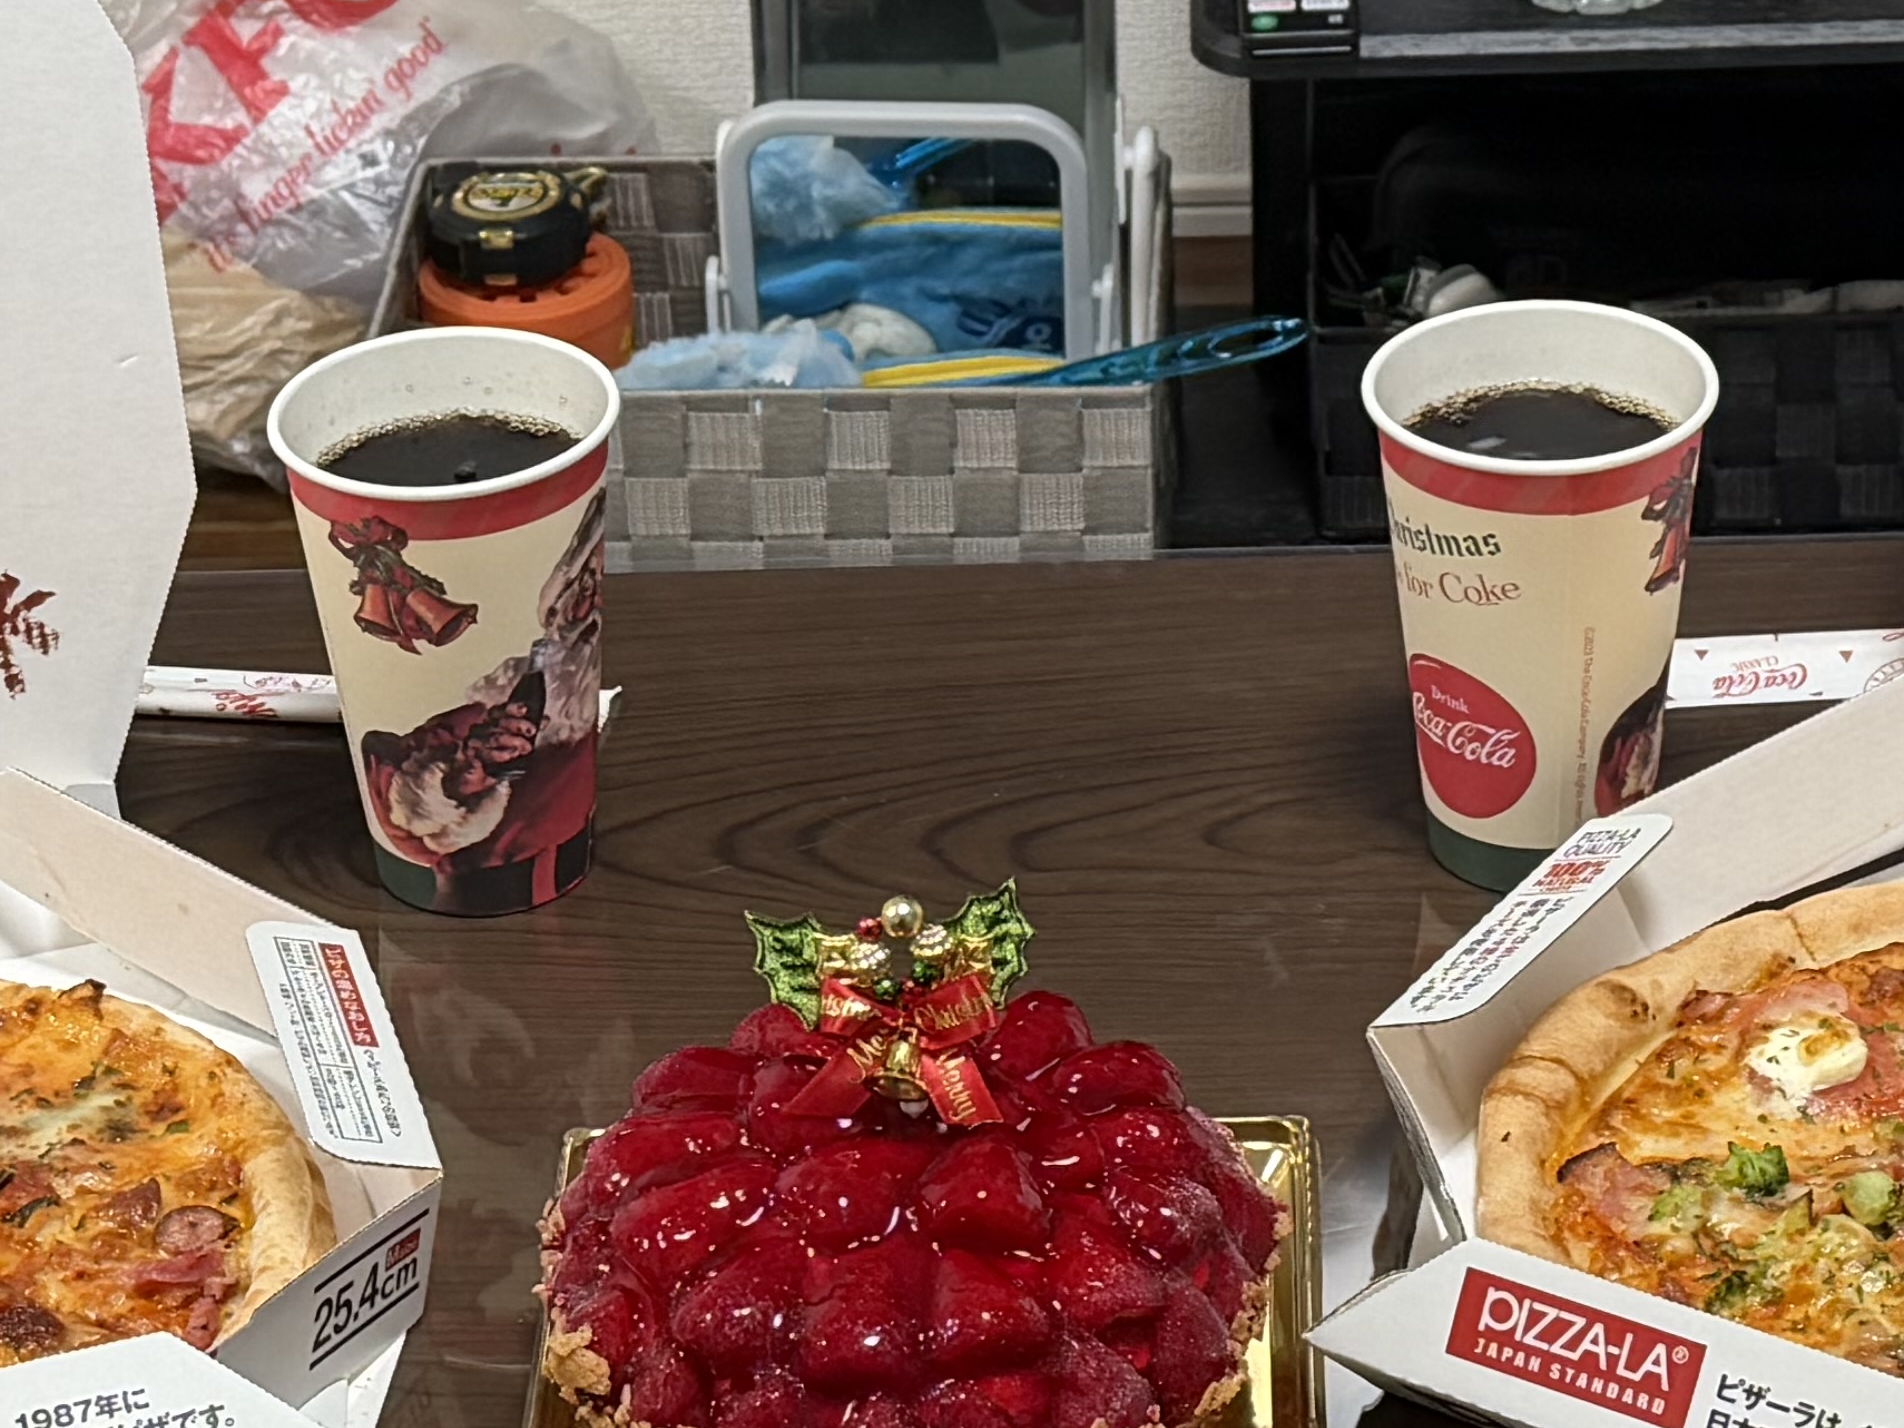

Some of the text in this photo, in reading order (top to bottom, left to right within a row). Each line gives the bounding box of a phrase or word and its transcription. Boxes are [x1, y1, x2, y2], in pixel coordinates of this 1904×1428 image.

[234, 152, 313, 235] finger
[1438, 571, 1522, 606] Coke
[1712, 662, 1809, 699] Coca-Cola
[1430, 684, 1471, 714] Drink
[1413, 691, 1522, 768] Coca-Cola
[1563, 840, 1632, 858] QUALITY
[1578, 828, 1641, 843] PIZZA-LA
[1545, 860, 1610, 878] 100%
[1473, 1341, 1666, 1416] JAPAN STANDARD
